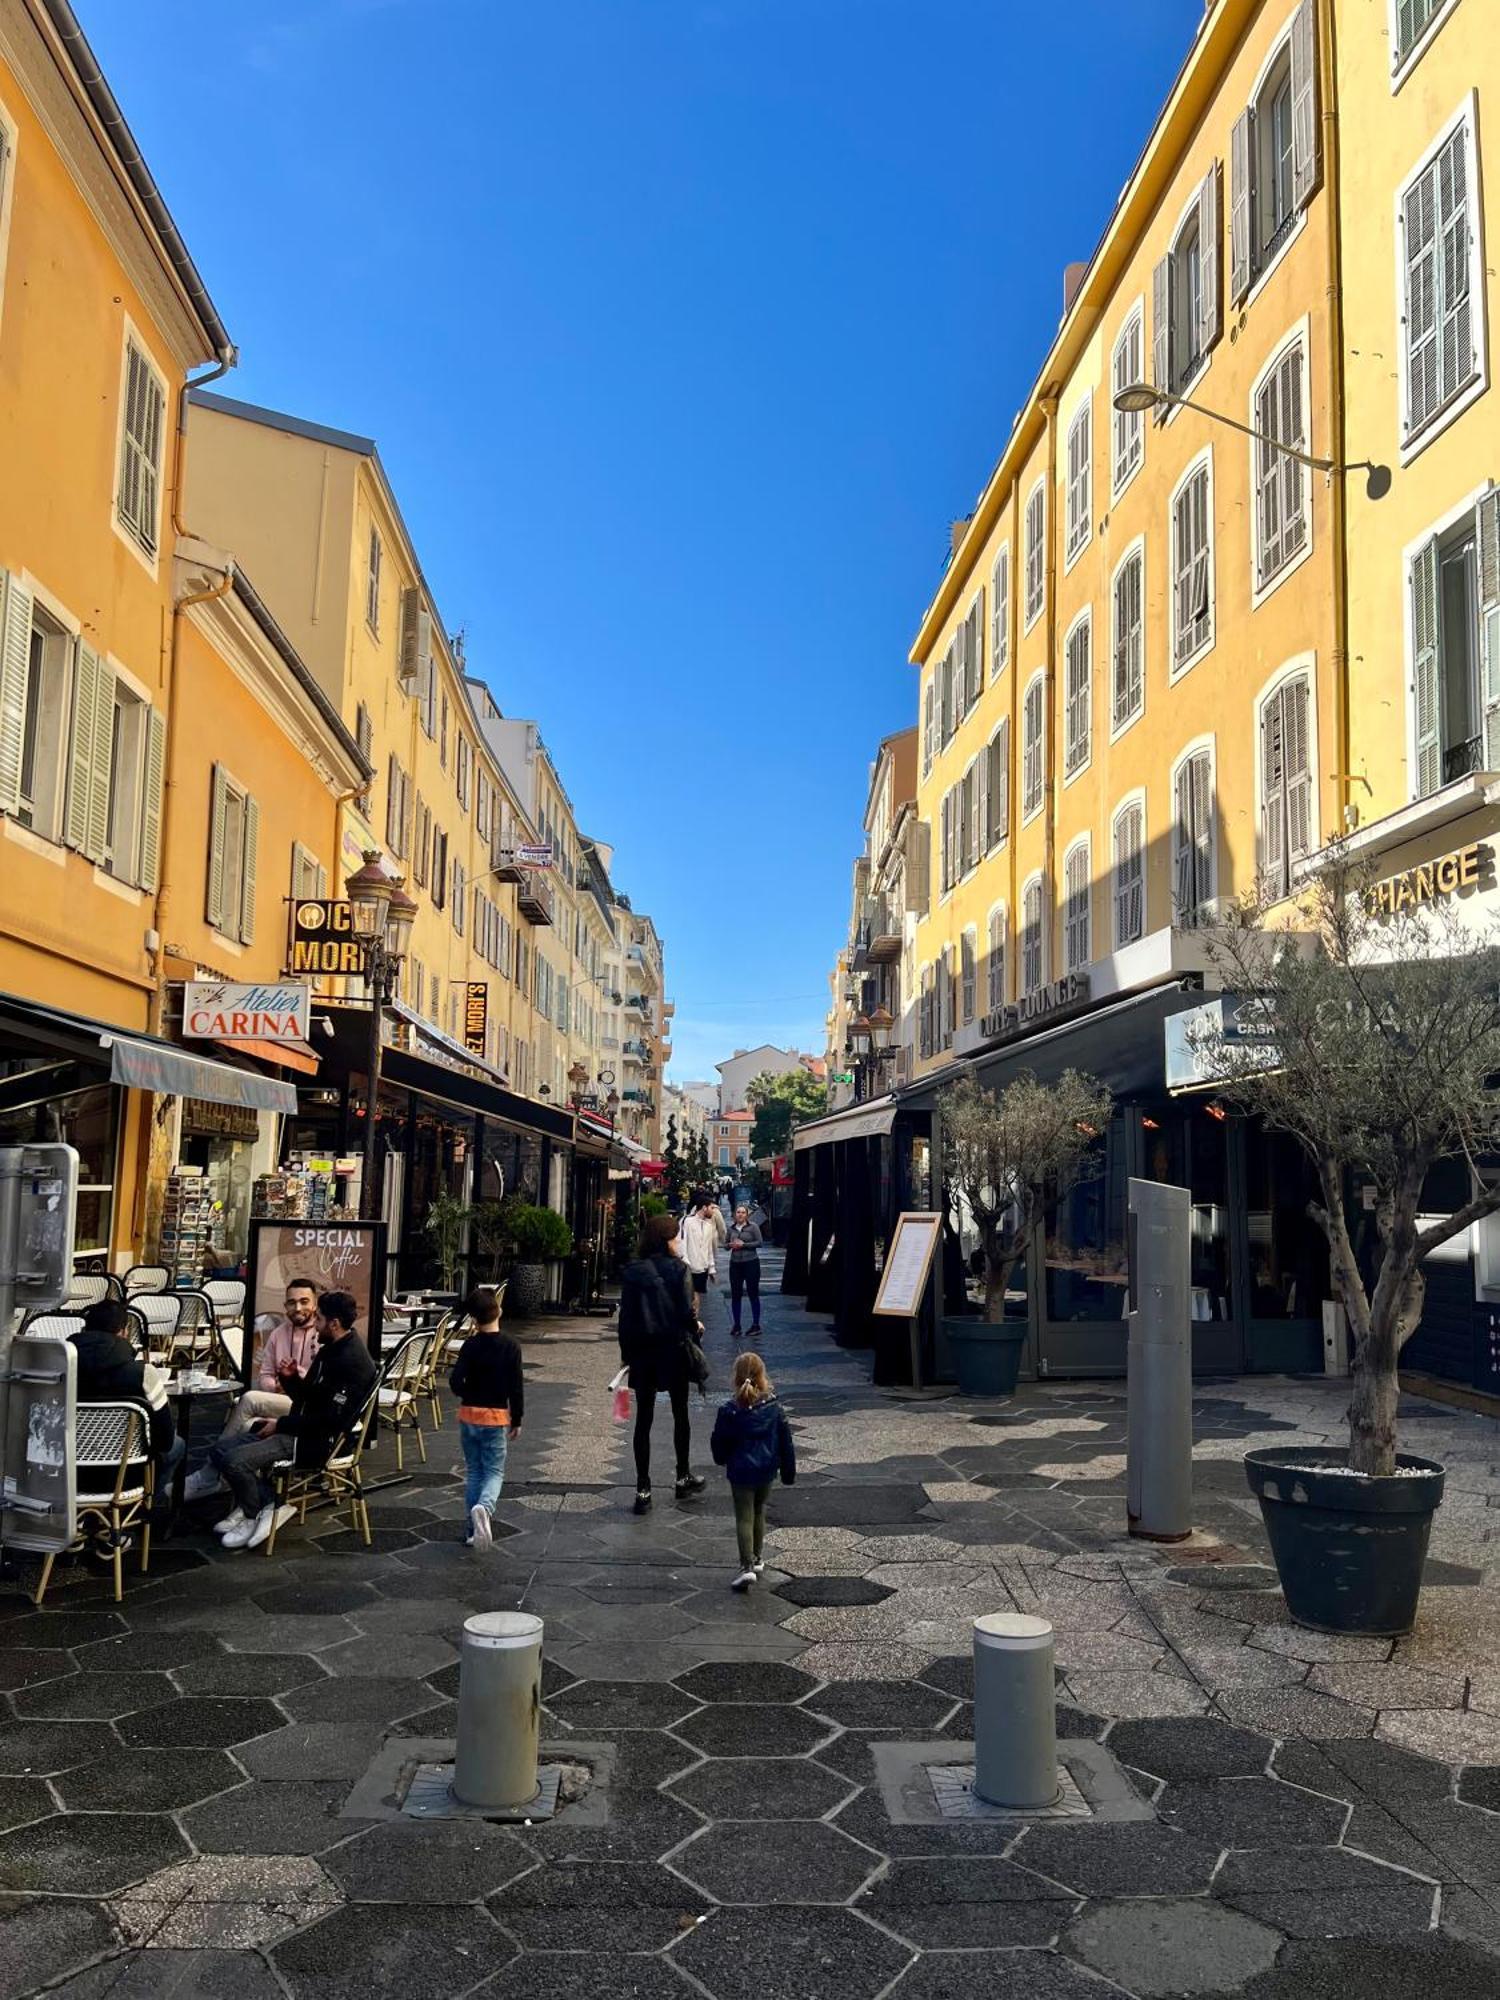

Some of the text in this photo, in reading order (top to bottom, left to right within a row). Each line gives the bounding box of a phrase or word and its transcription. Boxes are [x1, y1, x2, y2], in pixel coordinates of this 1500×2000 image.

[224, 987, 300, 1012] Atelier
[466, 984, 486, 1033] MORI'S
[1016, 973, 1080, 1023] LOUNGE
[190, 1011, 302, 1037] CARINA
[294, 1229, 365, 1248] SPECIAL
[320, 1244, 362, 1279] Coffee
